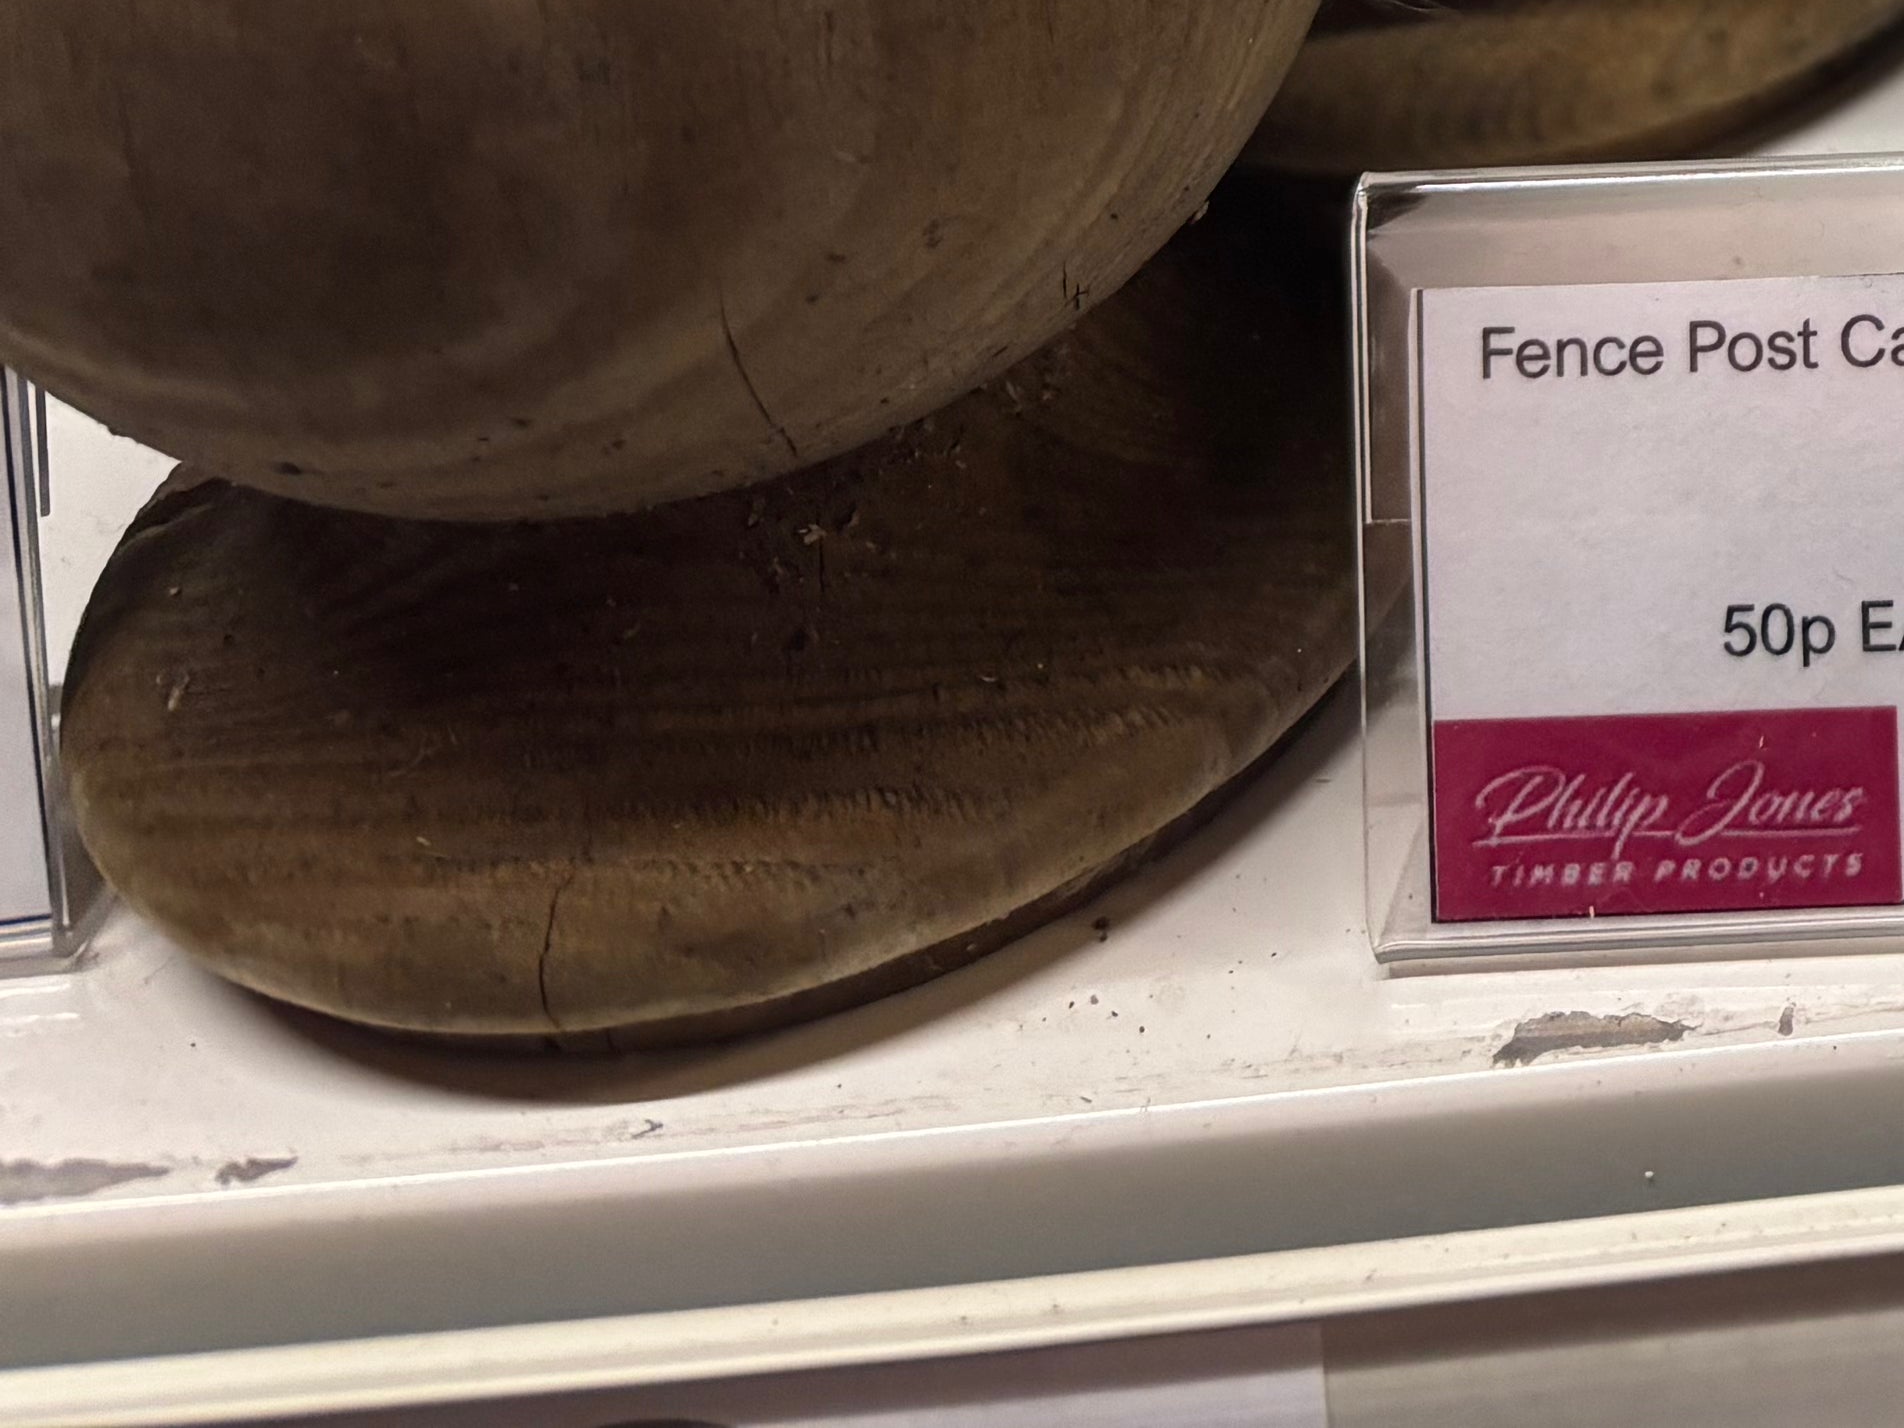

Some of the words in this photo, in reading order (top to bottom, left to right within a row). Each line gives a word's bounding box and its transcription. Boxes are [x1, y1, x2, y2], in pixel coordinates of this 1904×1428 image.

[1481, 324, 1664, 380] Fence
[1688, 318, 1818, 373] Post
[1722, 603, 1836, 667] 50p
[1475, 765, 1669, 859] Philip
[1674, 760, 1866, 847] Jones
[1491, 859, 1635, 887] TIMBER
[1653, 852, 1864, 883] PRODUCTS
